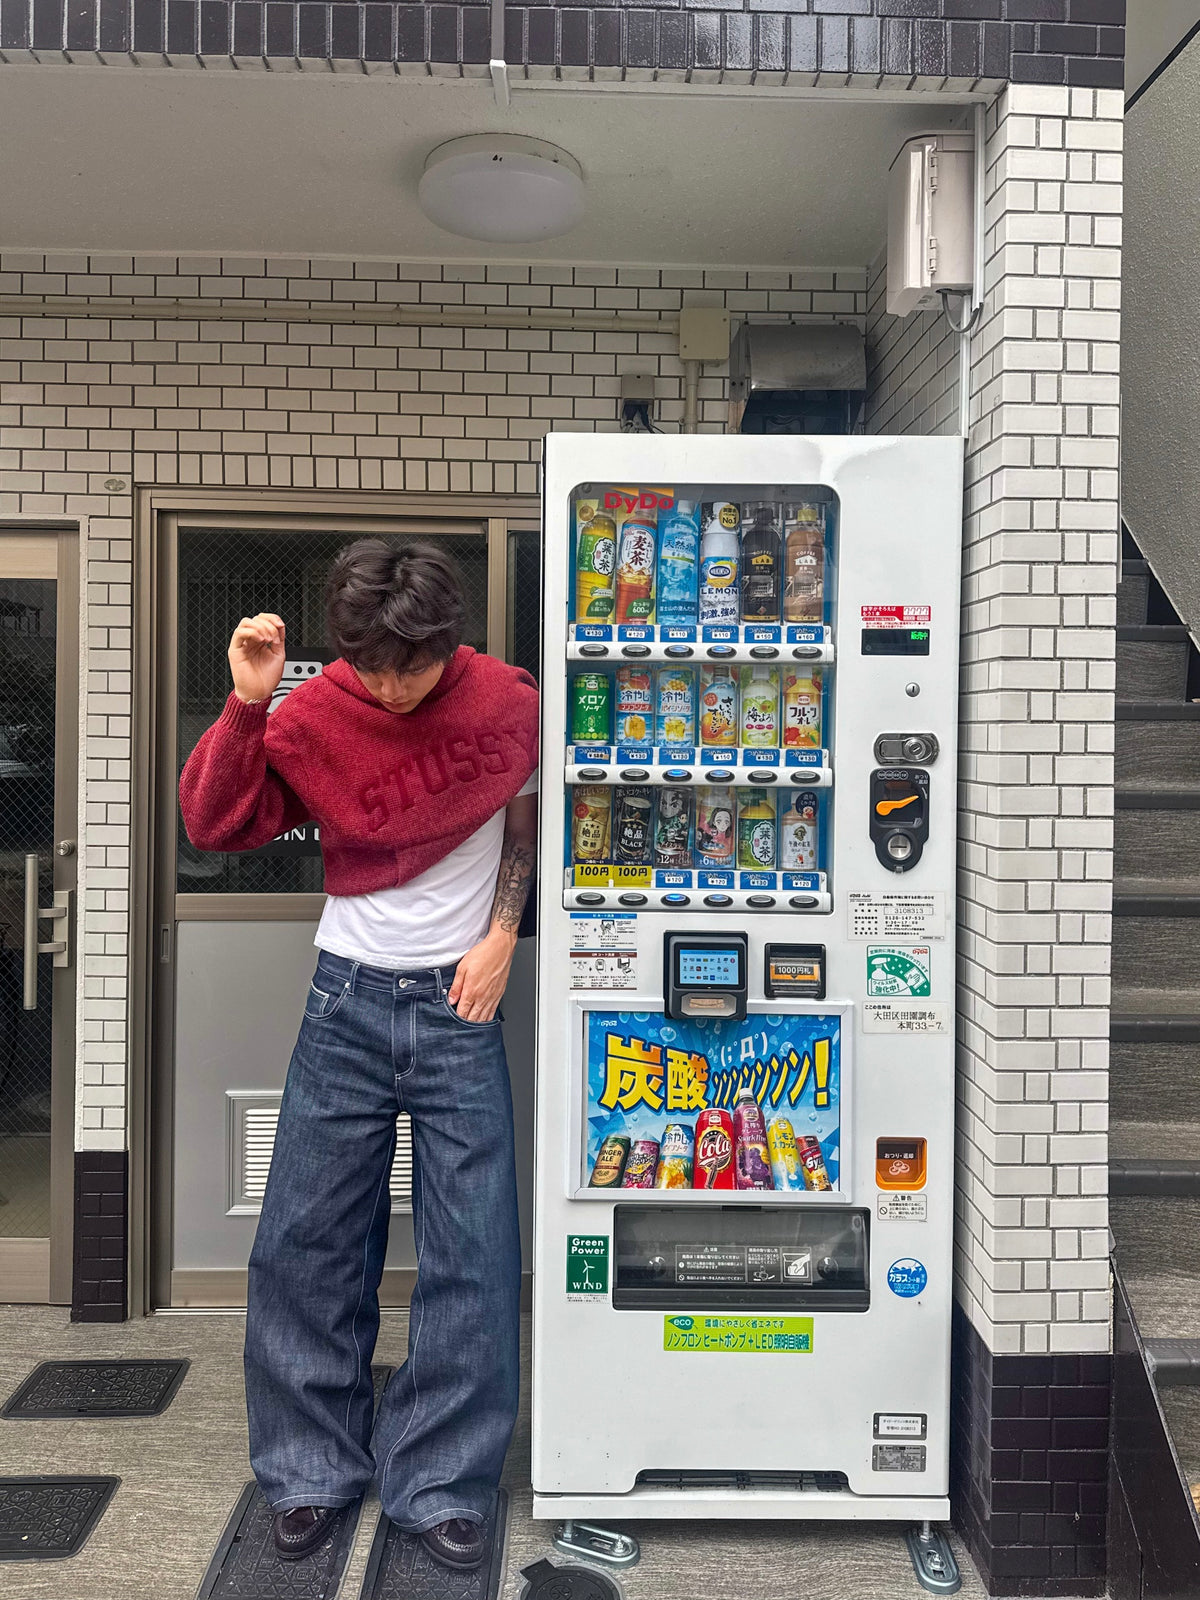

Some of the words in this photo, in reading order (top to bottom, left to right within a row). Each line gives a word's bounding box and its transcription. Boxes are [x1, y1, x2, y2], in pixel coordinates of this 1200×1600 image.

[604, 492, 674, 514] DyDo
[664, 539, 691, 551] 天然水
[630, 534, 648, 567] 麦茶
[796, 550, 816, 558] COFFEE
[701, 587, 738, 595] LEMON
[578, 695, 606, 705] メロン
[621, 691, 650, 702] 冷やし
[662, 691, 691, 703] 冷やし
[789, 707, 817, 718] フルーツ
[359, 729, 540, 834] STUSSY
[582, 827, 601, 839] 絶品
[623, 827, 643, 839] 絶品
[620, 838, 643, 848] BLACK
[760, 826, 772, 859] 葉の茶
[580, 866, 609, 876] 100円
[618, 867, 648, 877] 100円
[778, 965, 812, 975] 1000円札
[873, 1011, 936, 1021] 大田区田園調布
[667, 1132, 690, 1145] 冷やし
[775, 1132, 794, 1141] レモン
[698, 1134, 731, 1160] Cola
[572, 1237, 604, 1246] Green
[571, 1246, 605, 1255] Power
[572, 1282, 603, 1290] WIND
[673, 1318, 692, 1326] eco
[705, 1318, 785, 1329] 環境にやさしく省エネです
